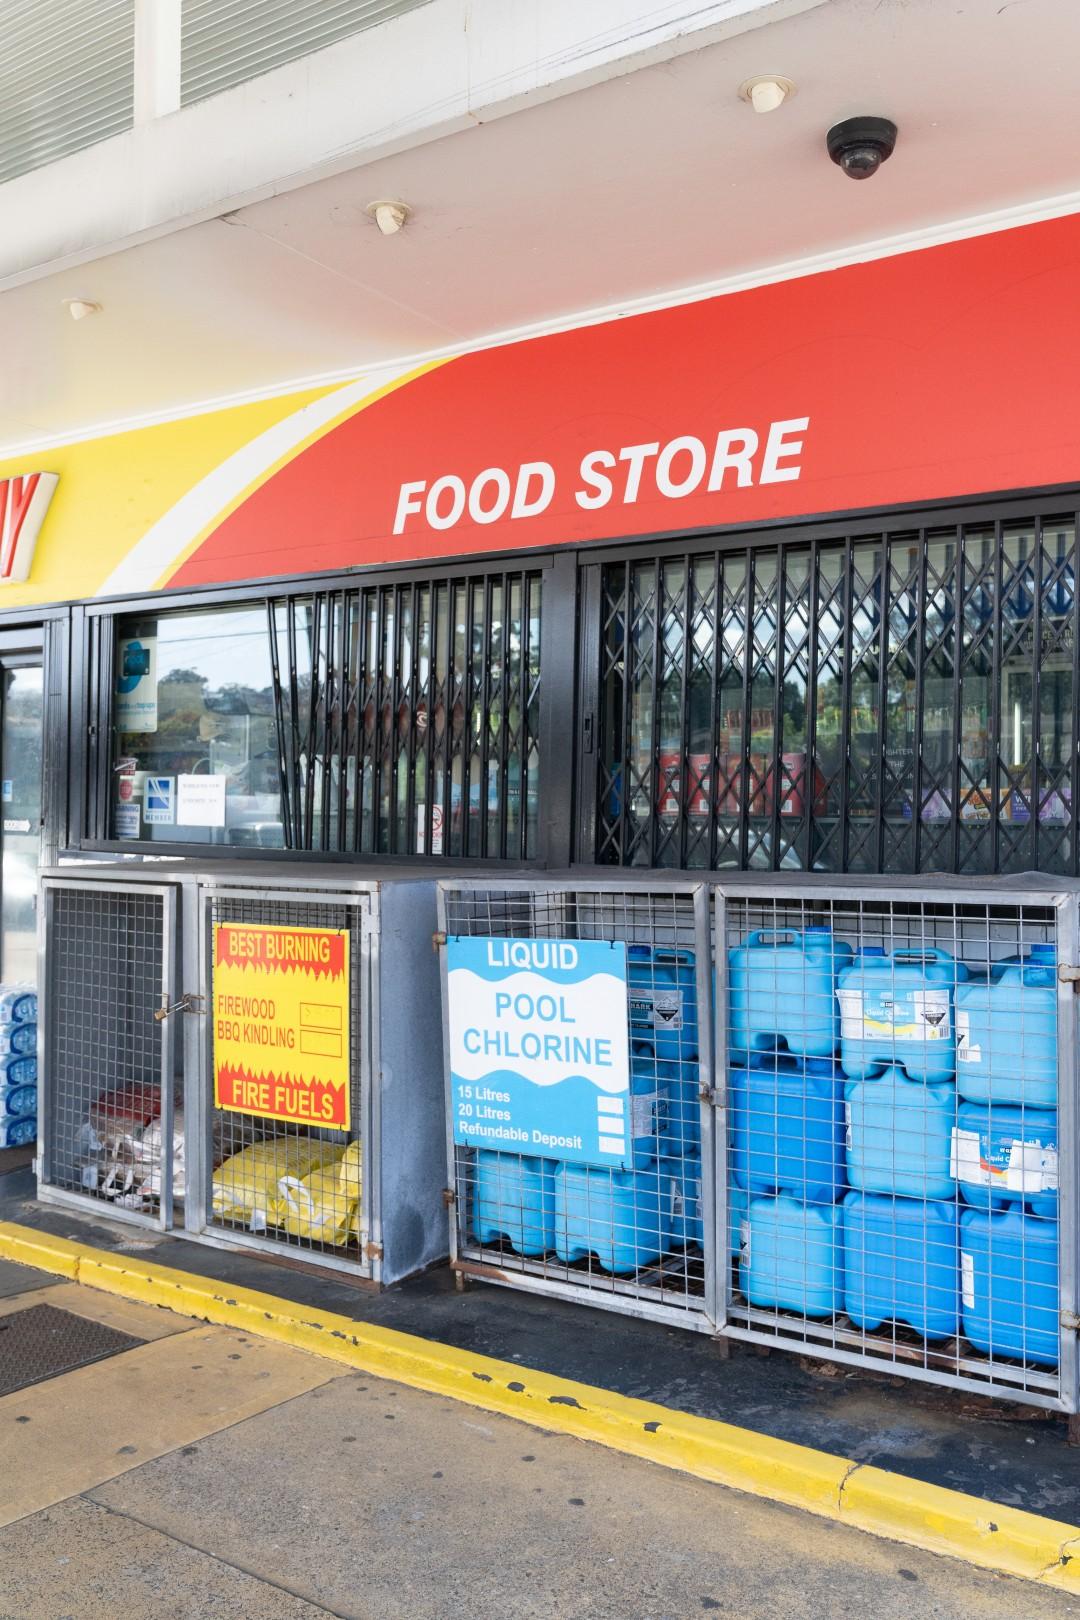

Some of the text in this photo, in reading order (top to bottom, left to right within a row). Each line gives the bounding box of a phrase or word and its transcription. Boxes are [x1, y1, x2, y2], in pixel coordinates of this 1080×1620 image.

[392, 415, 810, 536] FOOD STORE
[229, 931, 330, 964] BEST BURNING
[487, 941, 579, 971] LIQUID
[218, 994, 276, 1020] FIREWOOD
[495, 992, 576, 1024] POOL
[217, 1020, 295, 1049] BBQ KINDLING
[463, 1028, 613, 1067] CHLORINE
[231, 1079, 334, 1120] FIRE FUELS
[458, 1085, 511, 1103] 15 Litres
[458, 1103, 511, 1121] 20 Litres
[459, 1121, 582, 1150] Refundable Deposit
